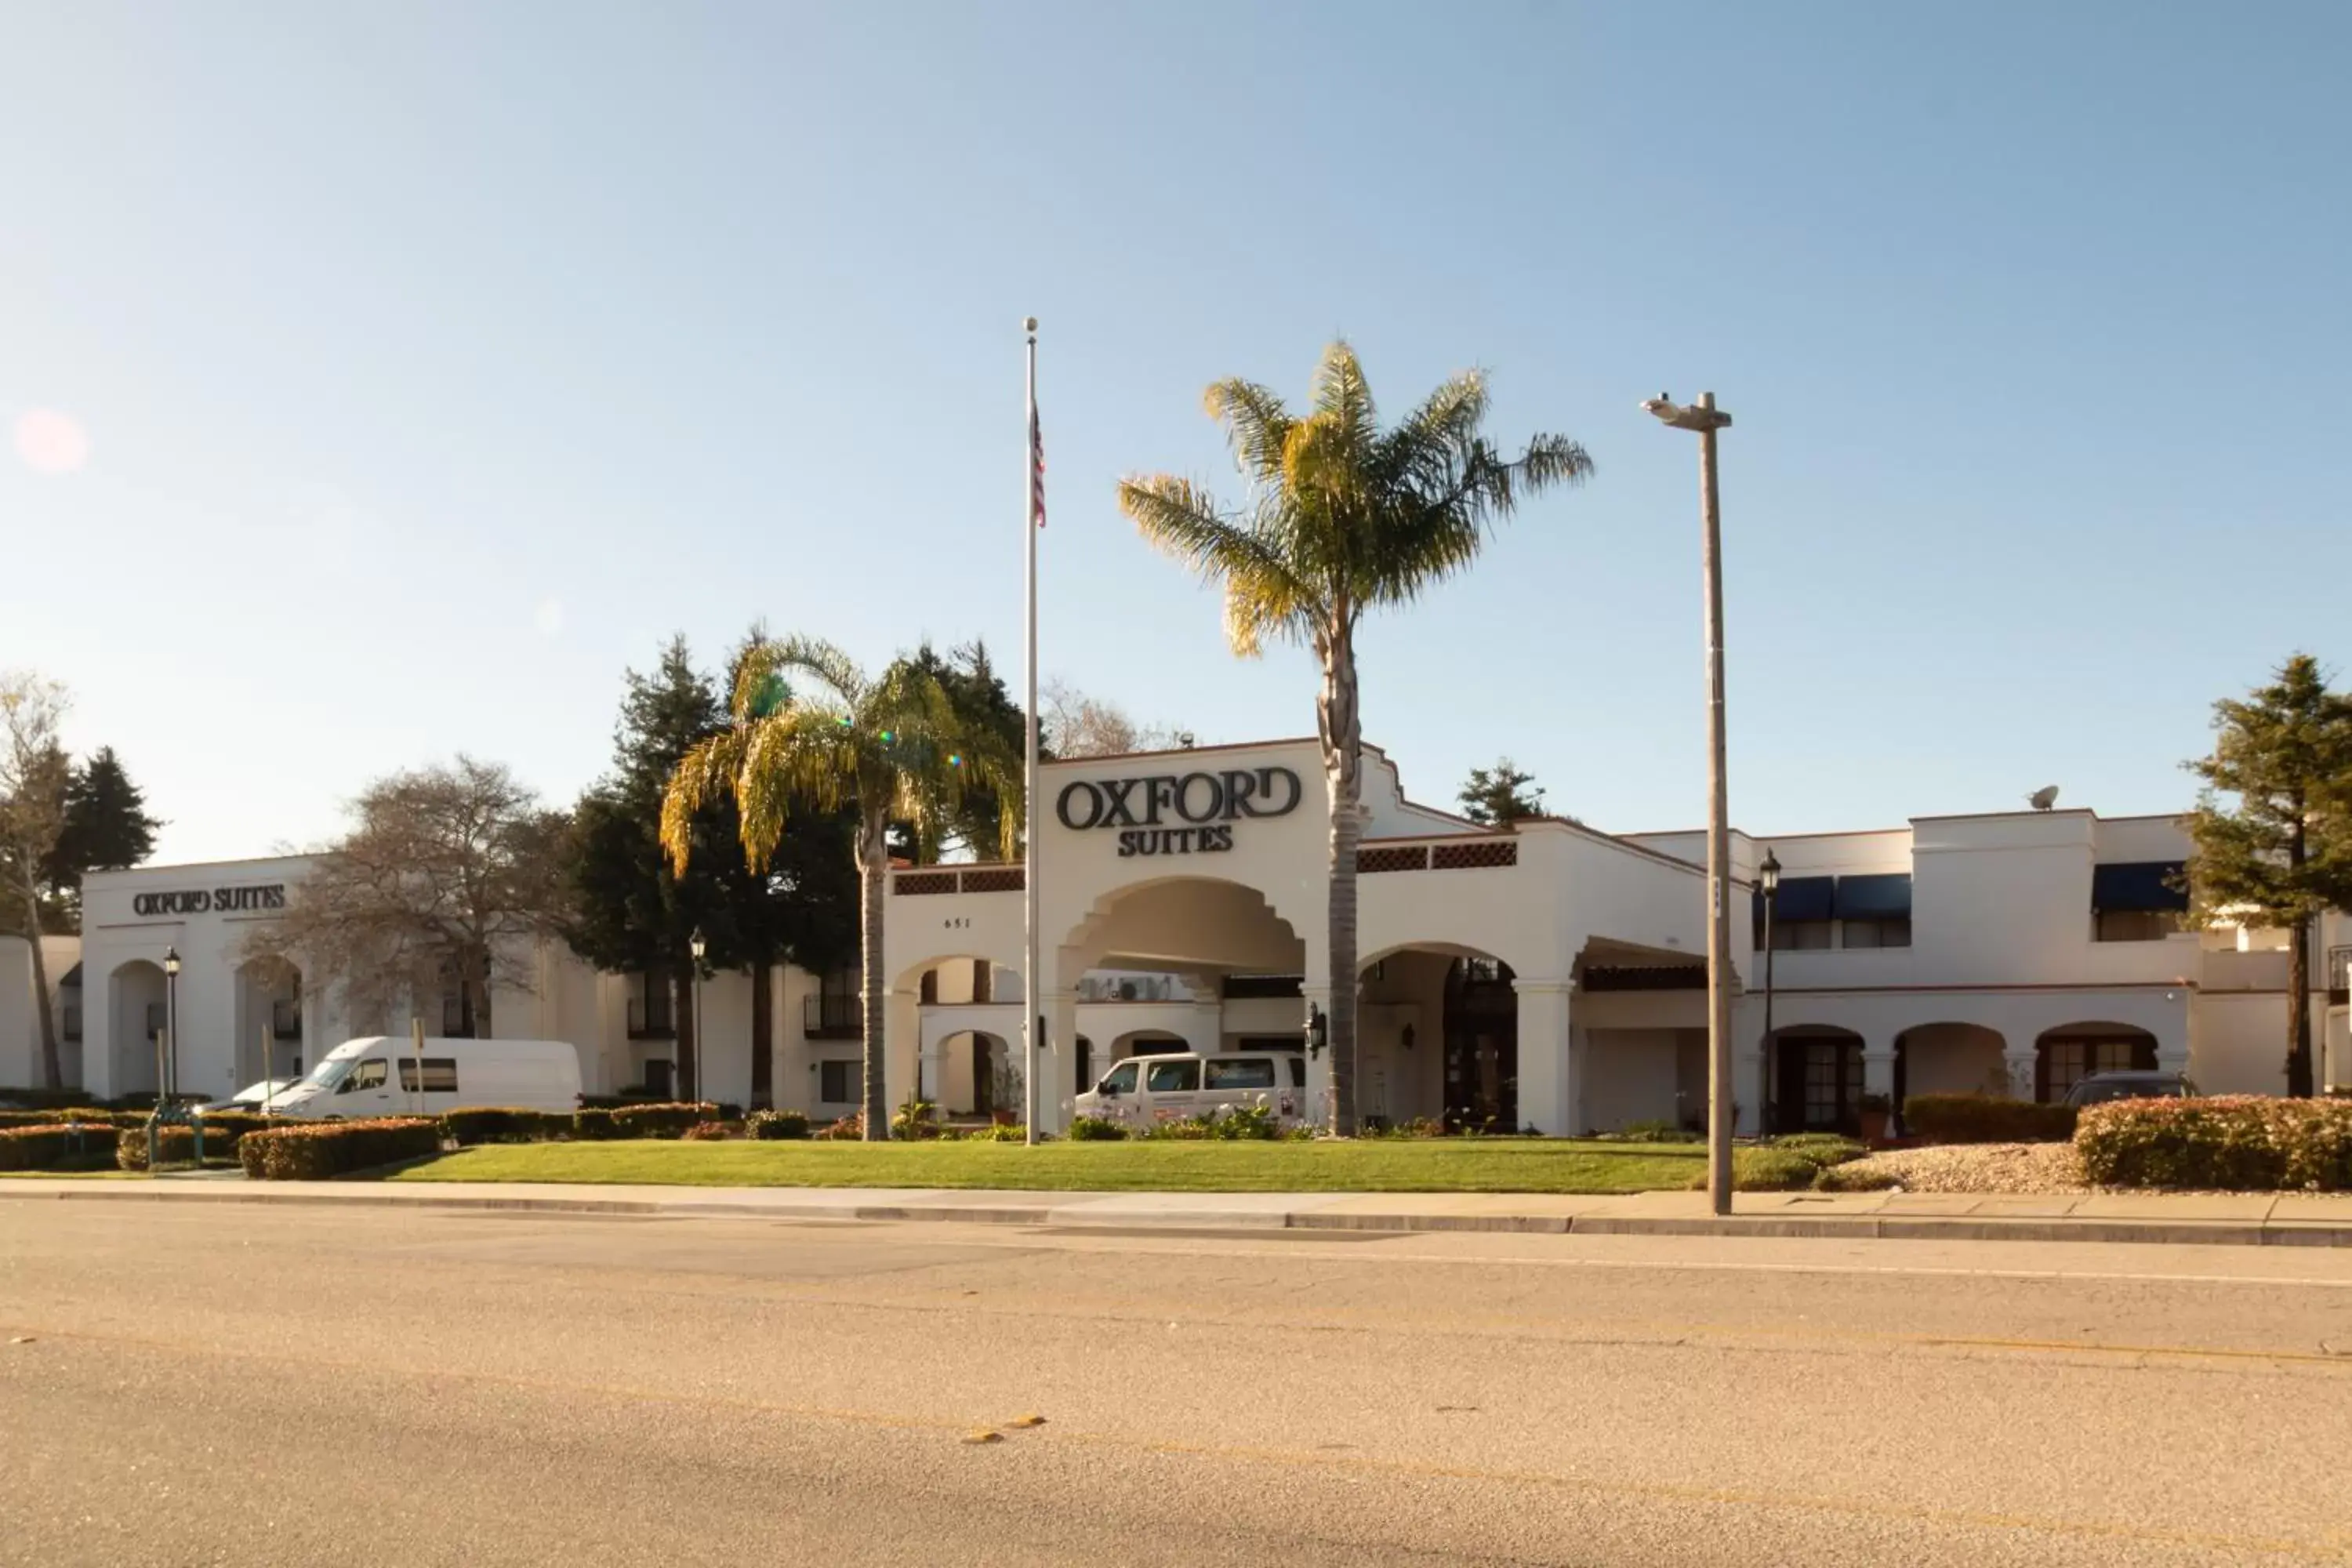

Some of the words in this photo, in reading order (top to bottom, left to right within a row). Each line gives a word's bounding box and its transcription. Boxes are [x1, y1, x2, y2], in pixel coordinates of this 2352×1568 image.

[1056, 767, 1302, 830] OXFORD
[1118, 825, 1234, 857] SUITES
[133, 890, 211, 916] OXFORD
[214, 884, 285, 912] SUITES
